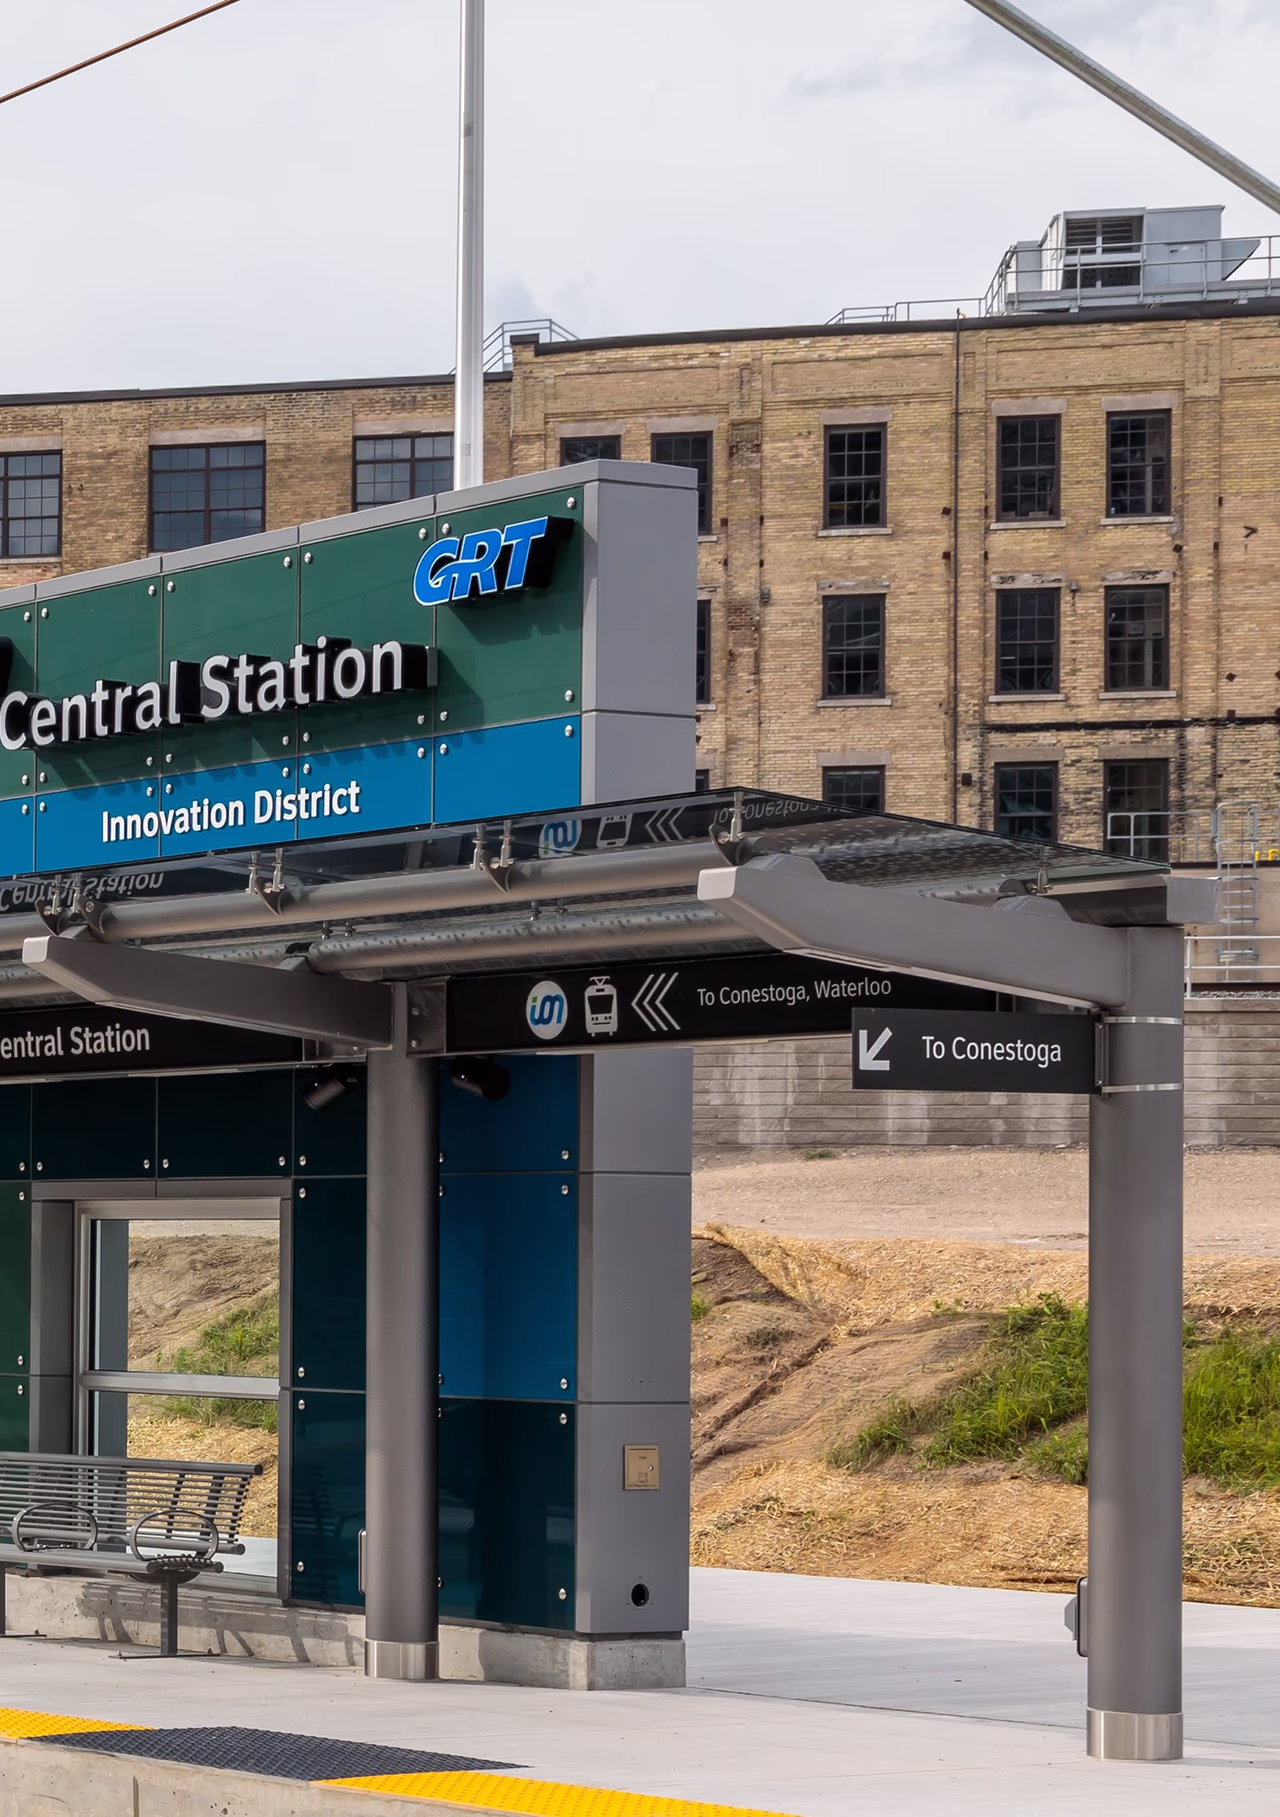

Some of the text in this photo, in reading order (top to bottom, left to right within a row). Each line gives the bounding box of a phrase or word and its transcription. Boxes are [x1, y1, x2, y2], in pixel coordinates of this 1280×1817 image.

[413, 516, 549, 606] GRT
[201, 635, 403, 718] Station
[102, 780, 361, 843] Innovation District
[697, 977, 892, 1006] To Conestoga, Waterloo
[69, 1022, 151, 1055] Station
[921, 1035, 1062, 1068] To Conestoga
